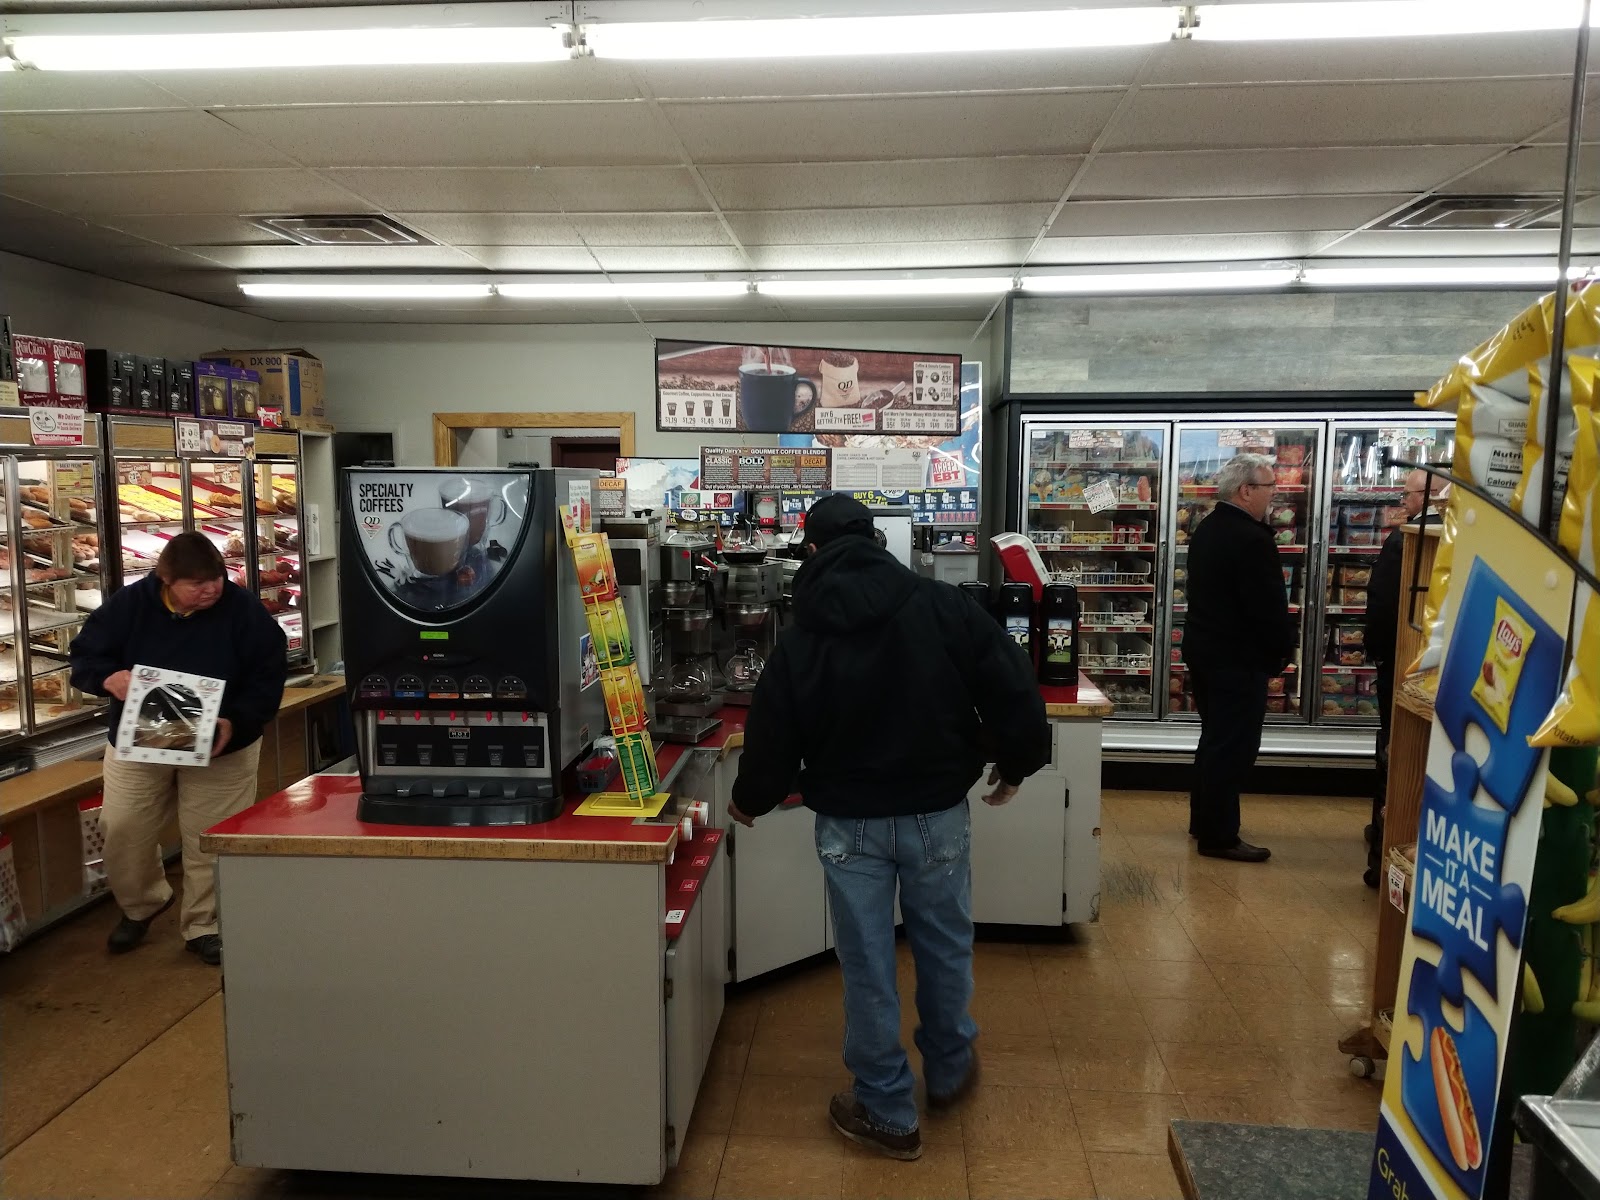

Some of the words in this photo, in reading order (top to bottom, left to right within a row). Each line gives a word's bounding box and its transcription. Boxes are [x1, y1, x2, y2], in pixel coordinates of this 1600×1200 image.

[844, 413, 861, 425] FREE!
[933, 462, 959, 474] ACCEPT
[934, 471, 960, 482] EBT
[359, 484, 413, 498] SPECIALTY
[360, 499, 403, 513] COFFEES
[364, 516, 381, 527] QD
[139, 668, 159, 678] QD
[200, 679, 219, 687] QD
[1426, 808, 1496, 882] MAKE
[1445, 858, 1459, 882] IT
[1459, 870, 1470, 893] A
[1422, 868, 1488, 952] MEAL
